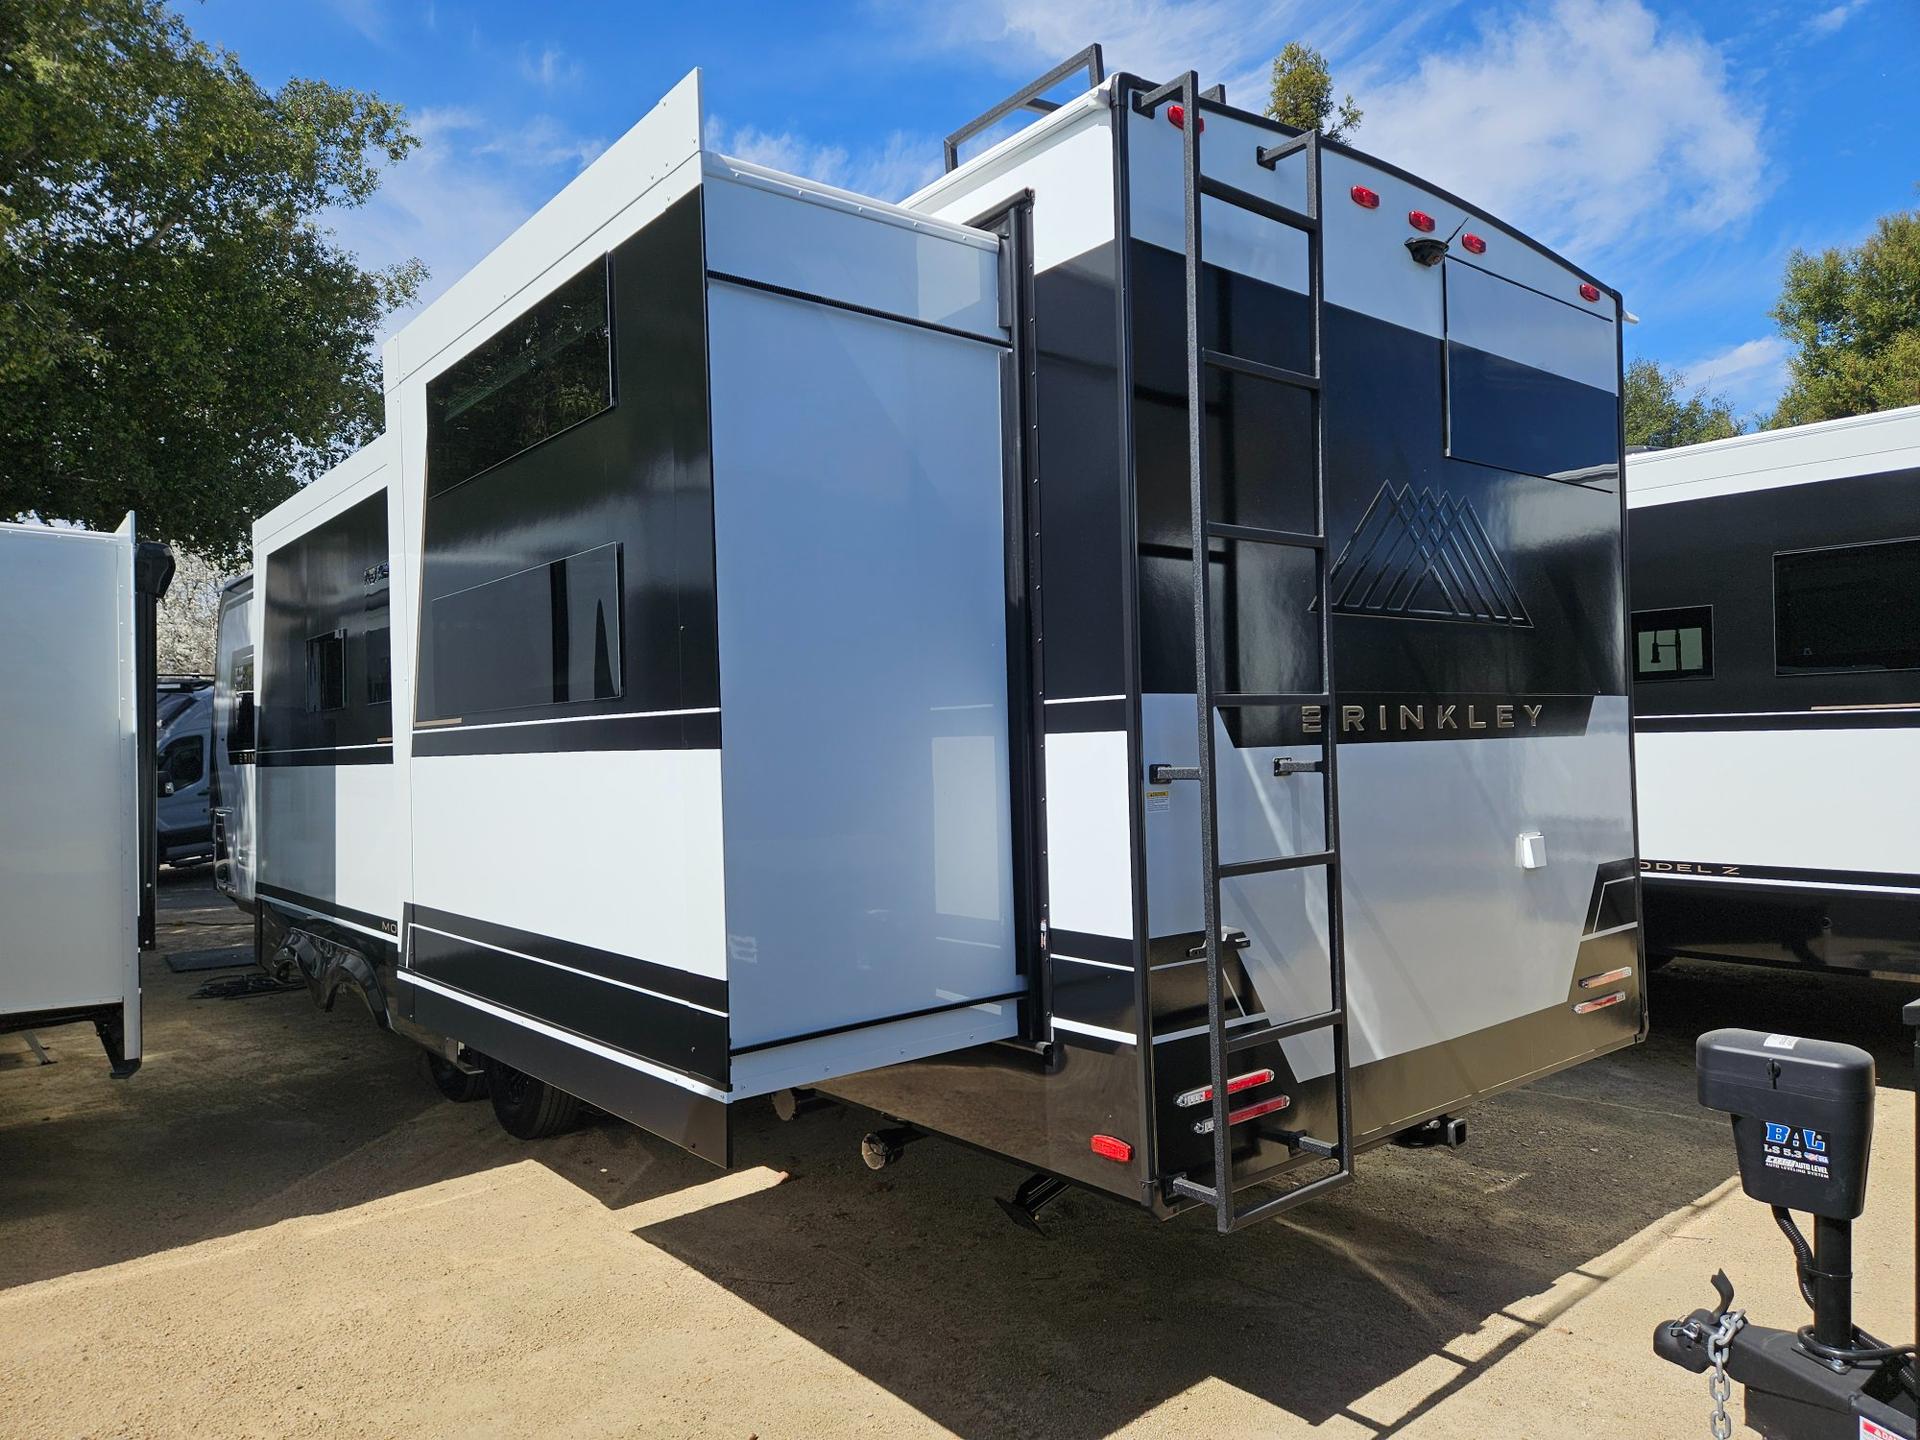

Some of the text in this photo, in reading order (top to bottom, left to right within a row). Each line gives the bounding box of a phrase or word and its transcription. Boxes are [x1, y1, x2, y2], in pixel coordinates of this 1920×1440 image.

[1301, 704, 1544, 733] BRINKLEY
[1721, 866, 1740, 875] Z
[1763, 1144, 1781, 1154] LS
[1782, 1148, 1802, 1158] 5.3
